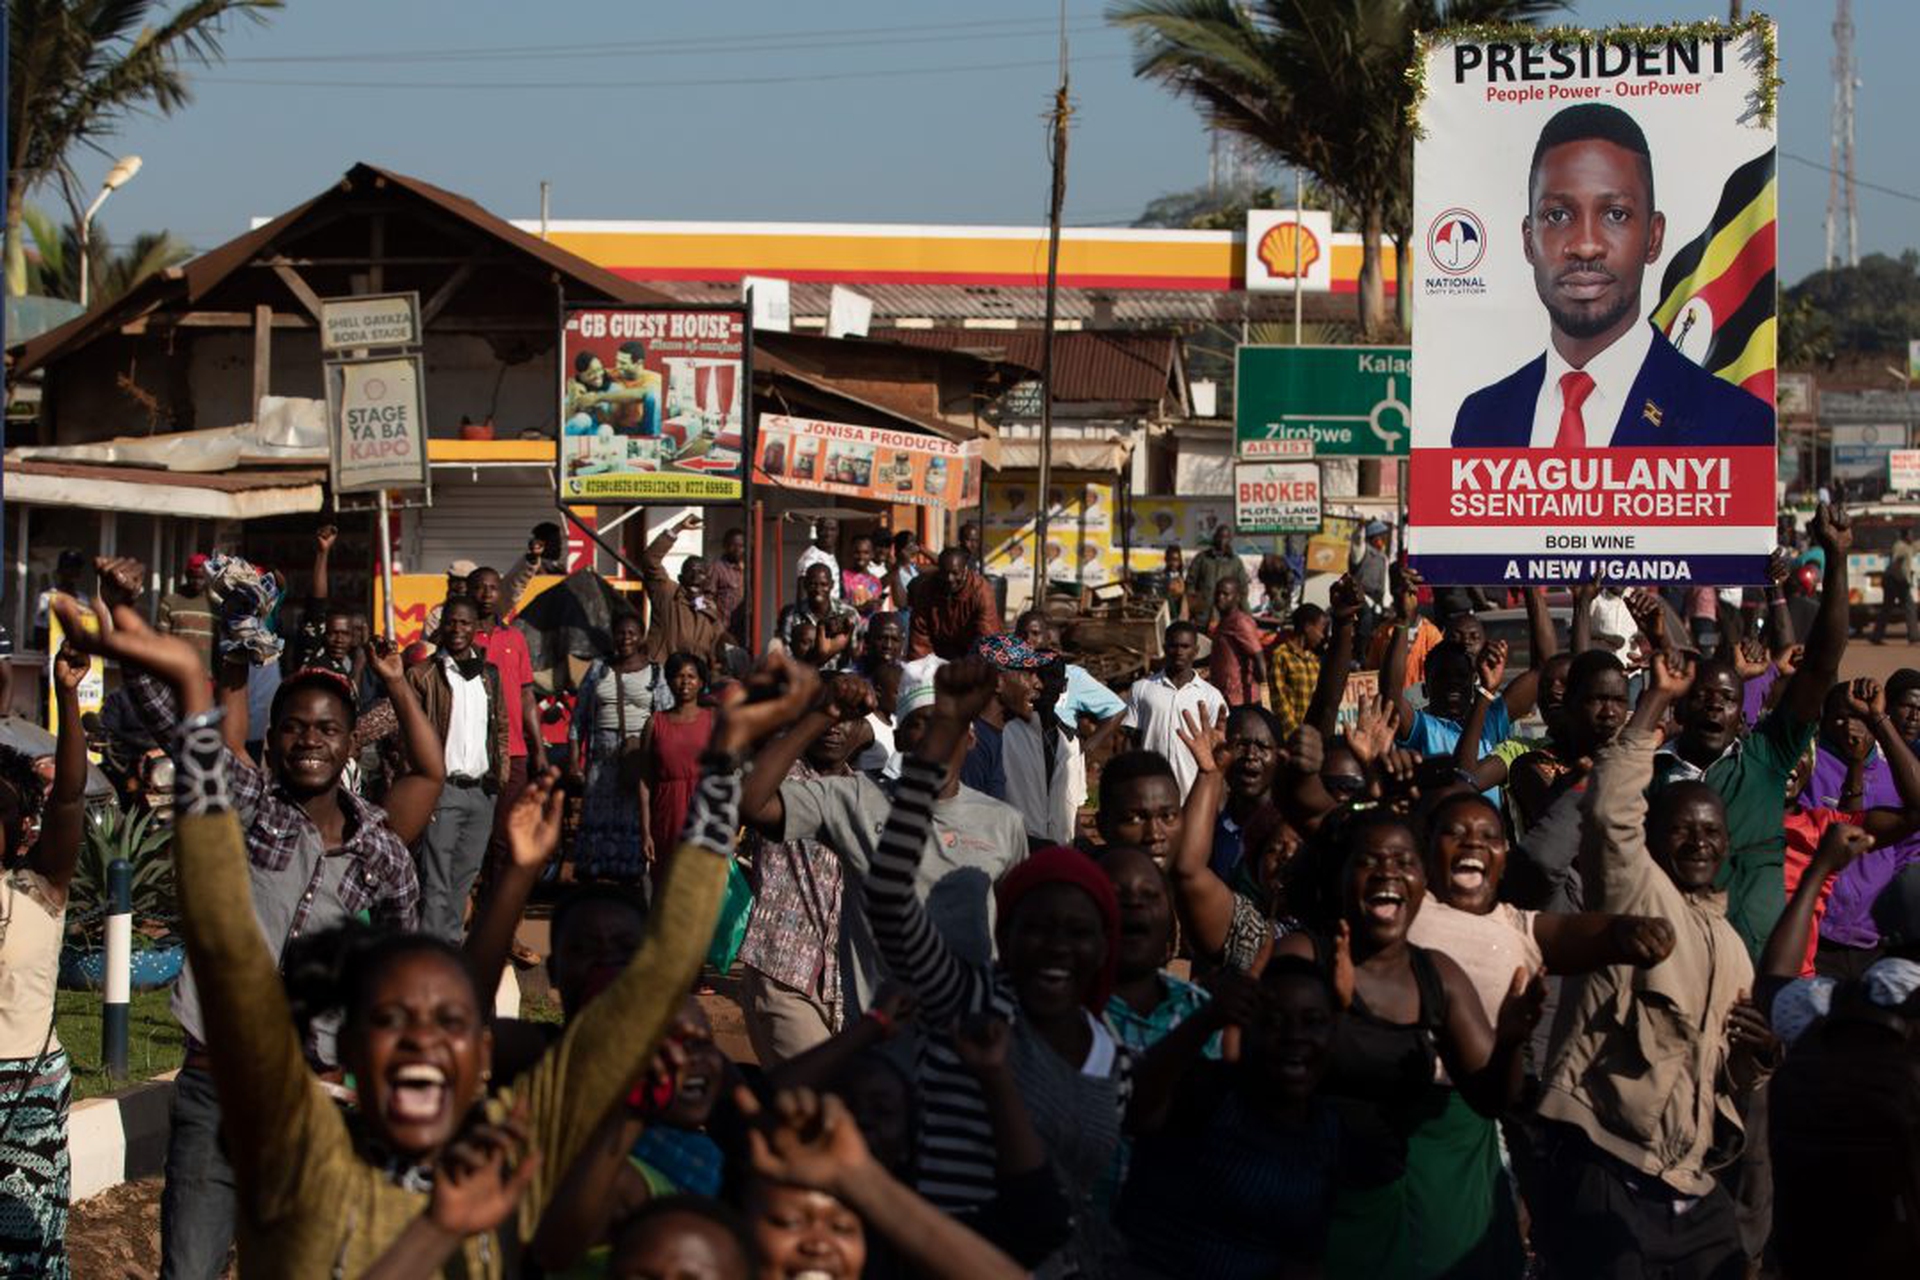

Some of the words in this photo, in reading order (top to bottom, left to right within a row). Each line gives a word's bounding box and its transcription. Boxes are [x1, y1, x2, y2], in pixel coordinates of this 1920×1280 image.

[1455, 36, 1732, 83] PRESIDENT
[1487, 85, 1544, 104] People
[1549, 83, 1600, 100] Power
[1615, 80, 1701, 98] OurPower
[1425, 278, 1486, 287] NATIONAL
[327, 317, 359, 328] SHELL
[580, 313, 606, 338] GB
[610, 314, 667, 338] GUEST
[670, 315, 730, 338] HOUSE
[334, 331, 368, 341] BODA
[348, 406, 406, 424] STAGE
[350, 425, 375, 440] YA
[382, 424, 407, 438] BA
[804, 422, 864, 441] JONISA
[870, 431, 959, 454] PRODUCTS
[1266, 423, 1352, 443] Zirobwe
[350, 440, 410, 460] KAPO
[1247, 442, 1309, 454] ARTIST
[1451, 458, 1730, 490] KYAGULANYI
[1239, 483, 1317, 503] BROKER
[1285, 506, 1318, 514] LAND
[1450, 493, 1603, 517] SSENTAMU
[1614, 493, 1731, 516] ROBERT
[1254, 516, 1304, 524] HOUSES
[1546, 536, 1587, 548] BOBI
[1592, 536, 1635, 548] WINE
[1504, 561, 1521, 579] A
[1528, 560, 1582, 579] NEW
[1590, 560, 1692, 579] UGANDA
